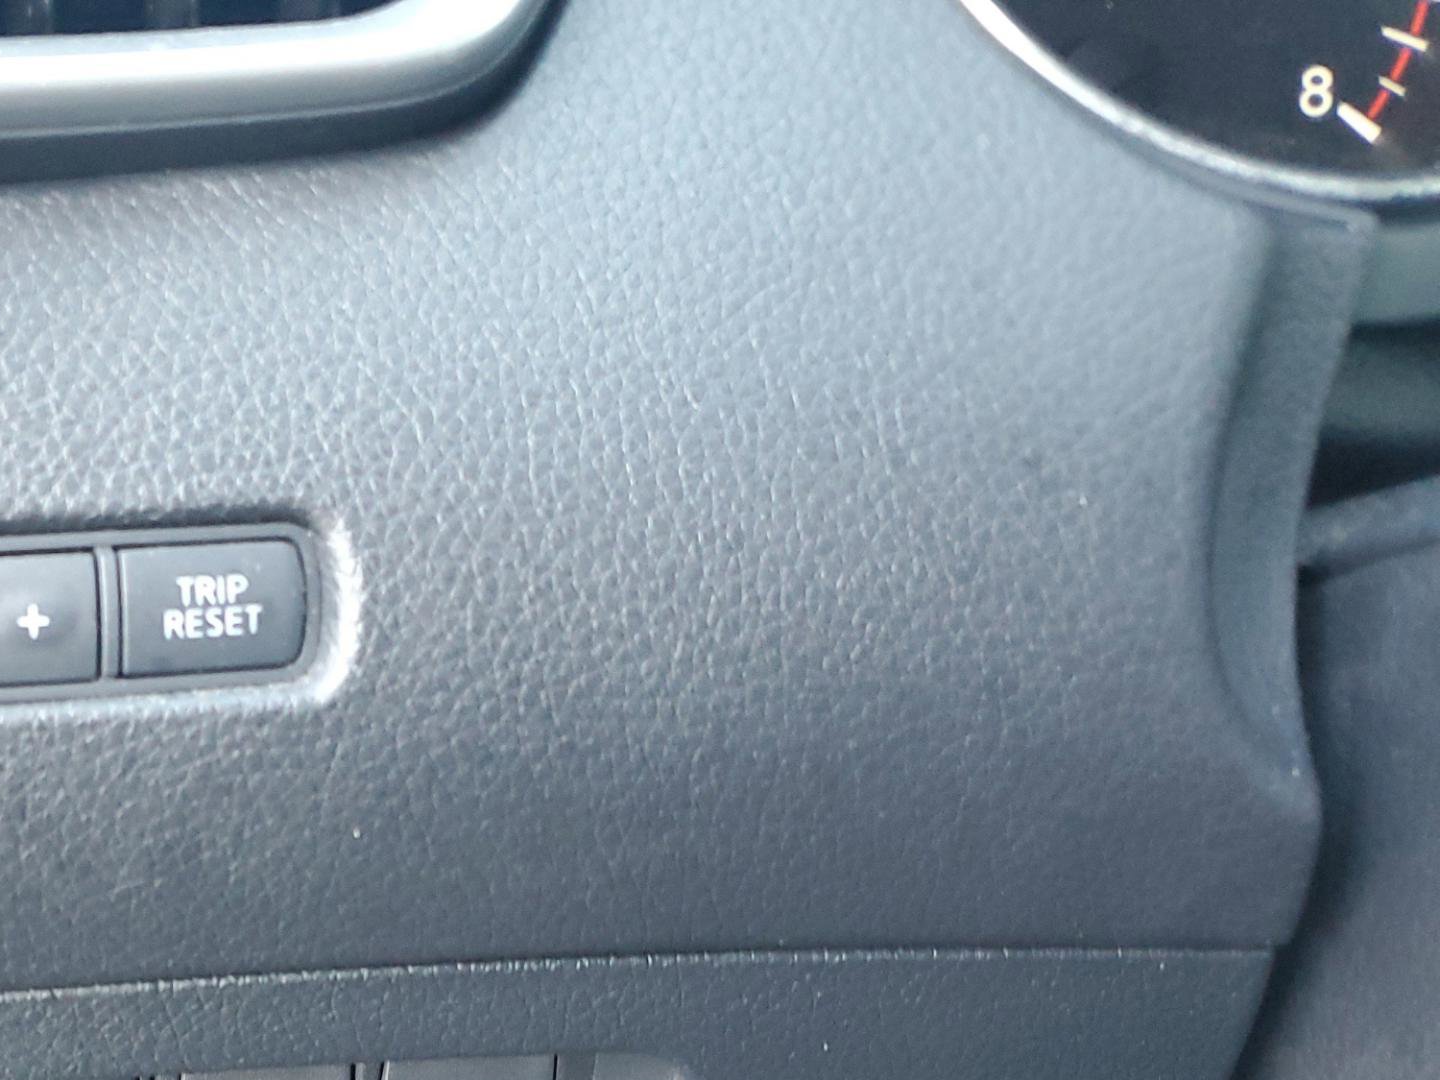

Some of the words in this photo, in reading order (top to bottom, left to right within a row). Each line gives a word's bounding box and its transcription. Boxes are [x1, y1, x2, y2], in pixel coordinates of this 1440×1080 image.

[1299, 64, 1334, 118] 8
[176, 574, 249, 605] TRIP
[163, 604, 263, 639] RESET
